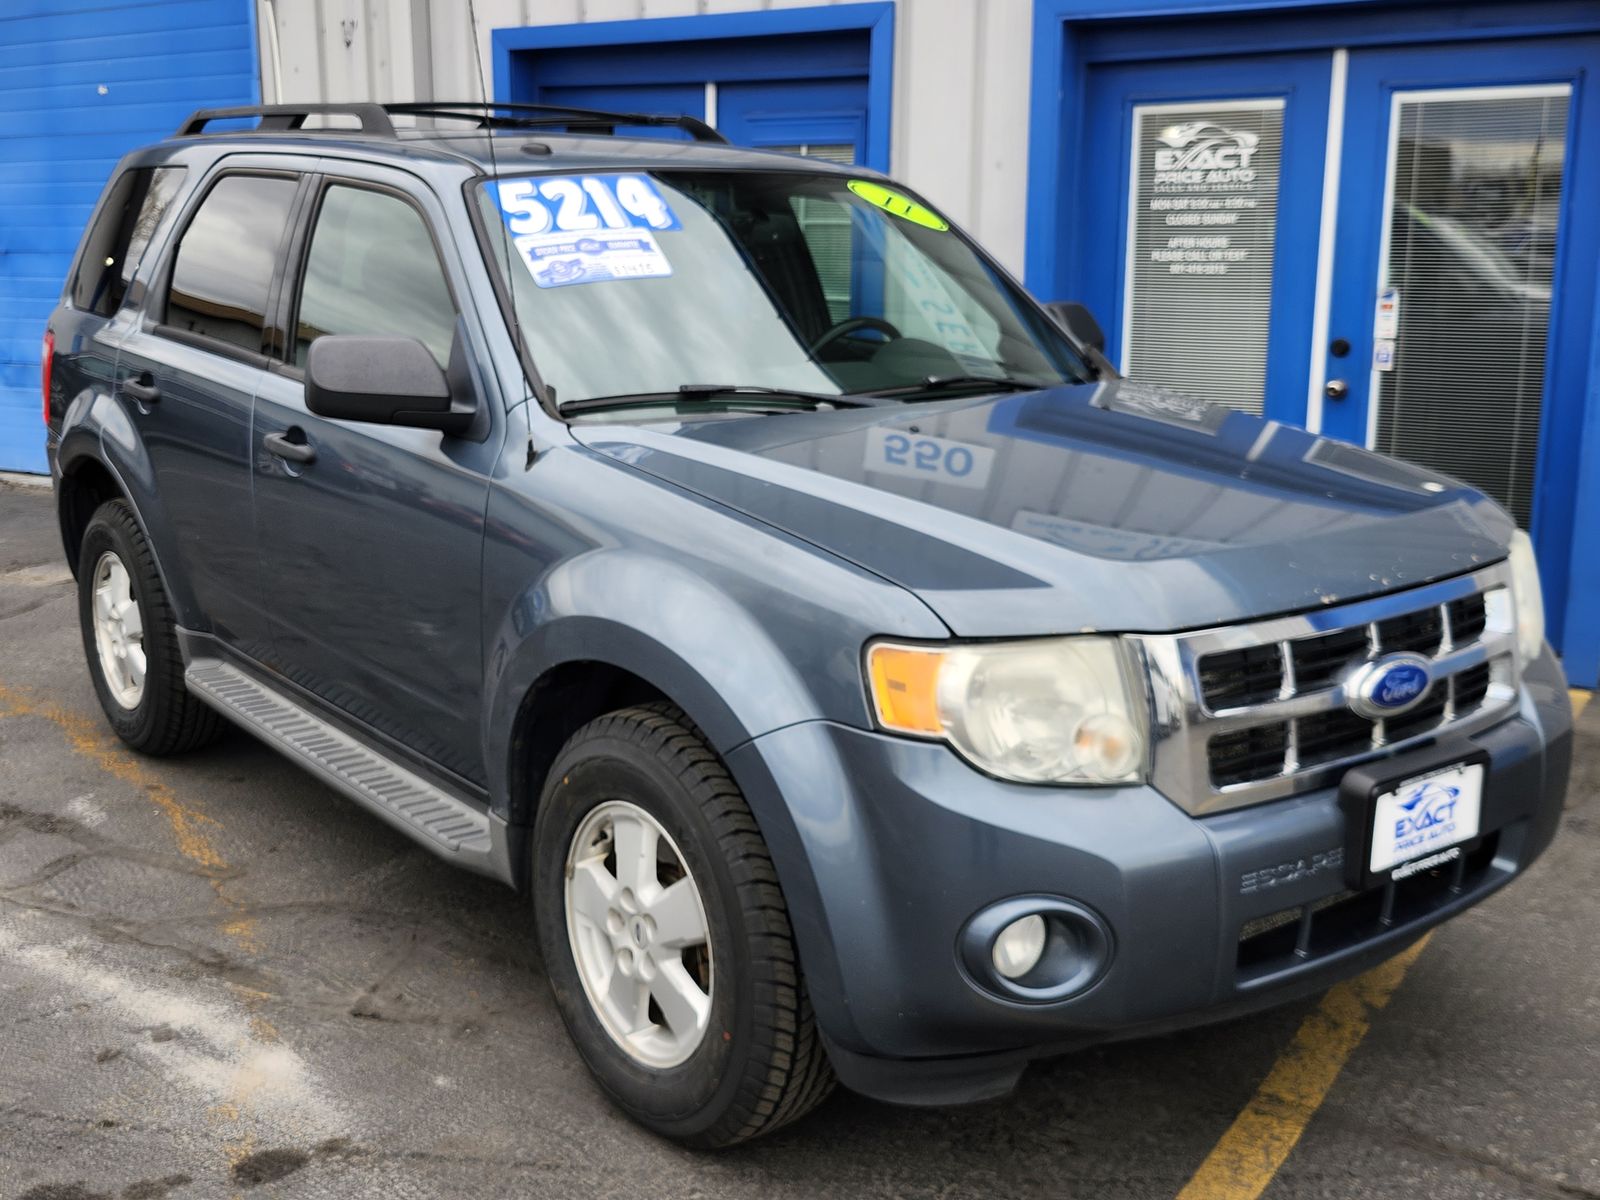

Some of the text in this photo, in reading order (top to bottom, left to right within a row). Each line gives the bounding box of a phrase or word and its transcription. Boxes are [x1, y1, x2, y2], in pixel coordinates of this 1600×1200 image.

[1155, 146, 1258, 170] EXACT
[1154, 169, 1257, 184] PRICE AUTO
[498, 176, 673, 235] 5214
[1165, 213, 1239, 225] CLOSED SUNDAY
[1168, 237, 1195, 248] AFTER
[1184, 251, 1207, 261] CALL
[1208, 250, 1222, 261] OR
[1223, 250, 1248, 260] TEXT
[1380, 667, 1422, 701] Ford
[1395, 800, 1458, 839] EXACT
[1428, 823, 1456, 840] AUTO
